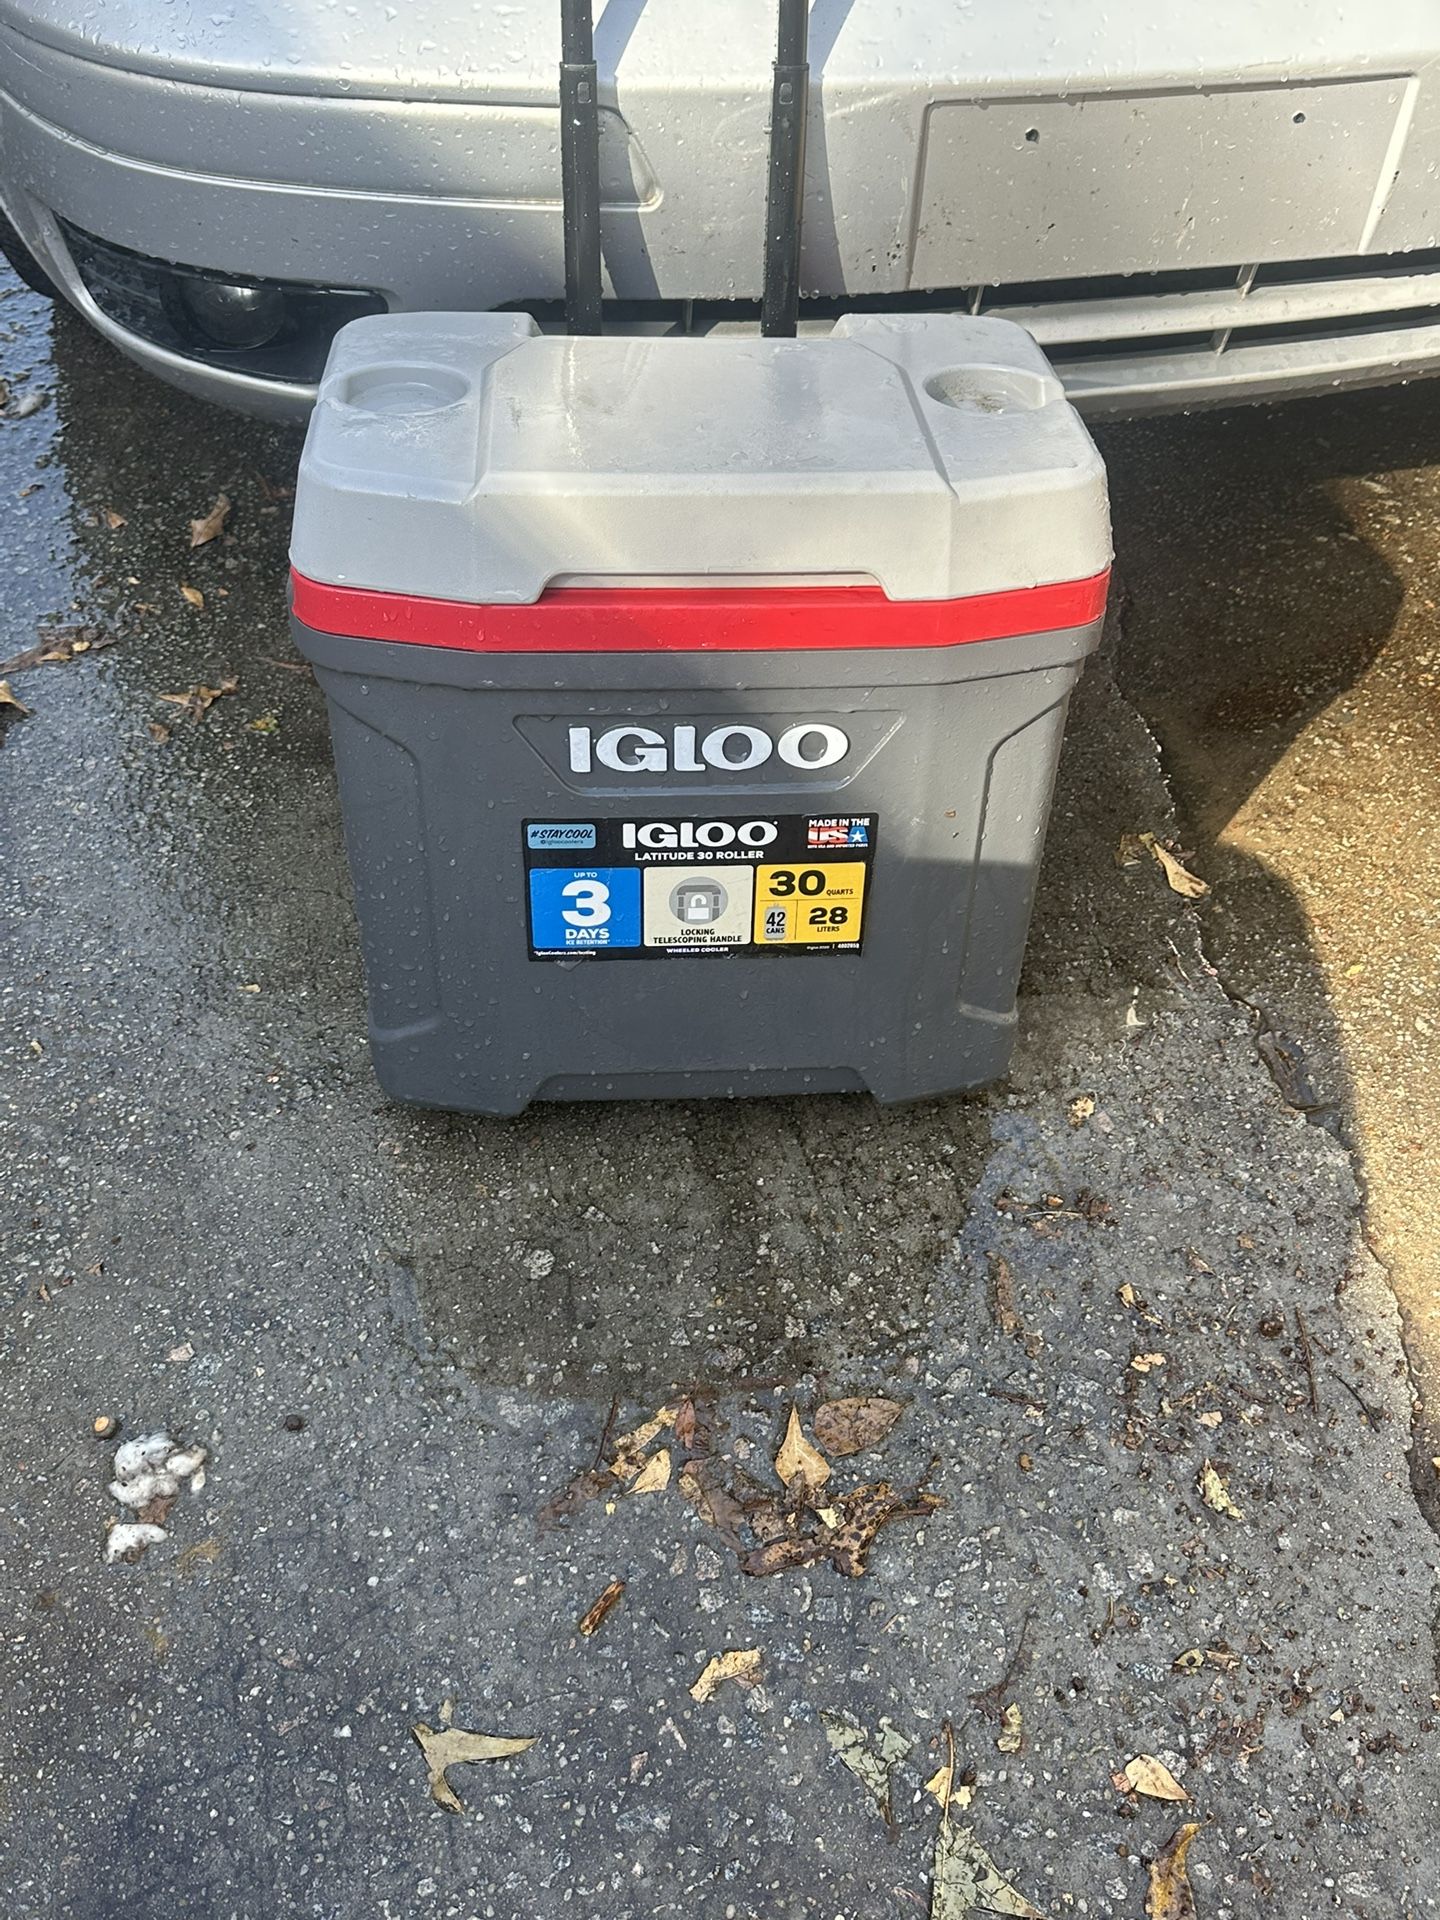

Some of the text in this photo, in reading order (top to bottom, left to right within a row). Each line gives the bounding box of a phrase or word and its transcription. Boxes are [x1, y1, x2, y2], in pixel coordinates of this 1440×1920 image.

[569, 725, 849, 773] IGLOO
[808, 817, 870, 827] MADE IN THE
[531, 829, 593, 839] #STAYCOOL
[622, 821, 778, 849] IGLOO
[807, 826, 869, 844] USA
[634, 850, 764, 861] LATITUDE 30 ROLLER
[769, 870, 826, 896] 30
[561, 879, 612, 927] 3
[766, 912, 786, 927] 42
[809, 906, 848, 925] 28
[565, 928, 610, 939] DAYS
[681, 928, 715, 936] LOCKING
[817, 925, 840, 933] LITERS
[653, 935, 742, 944] TELESCOPING HANDLE
